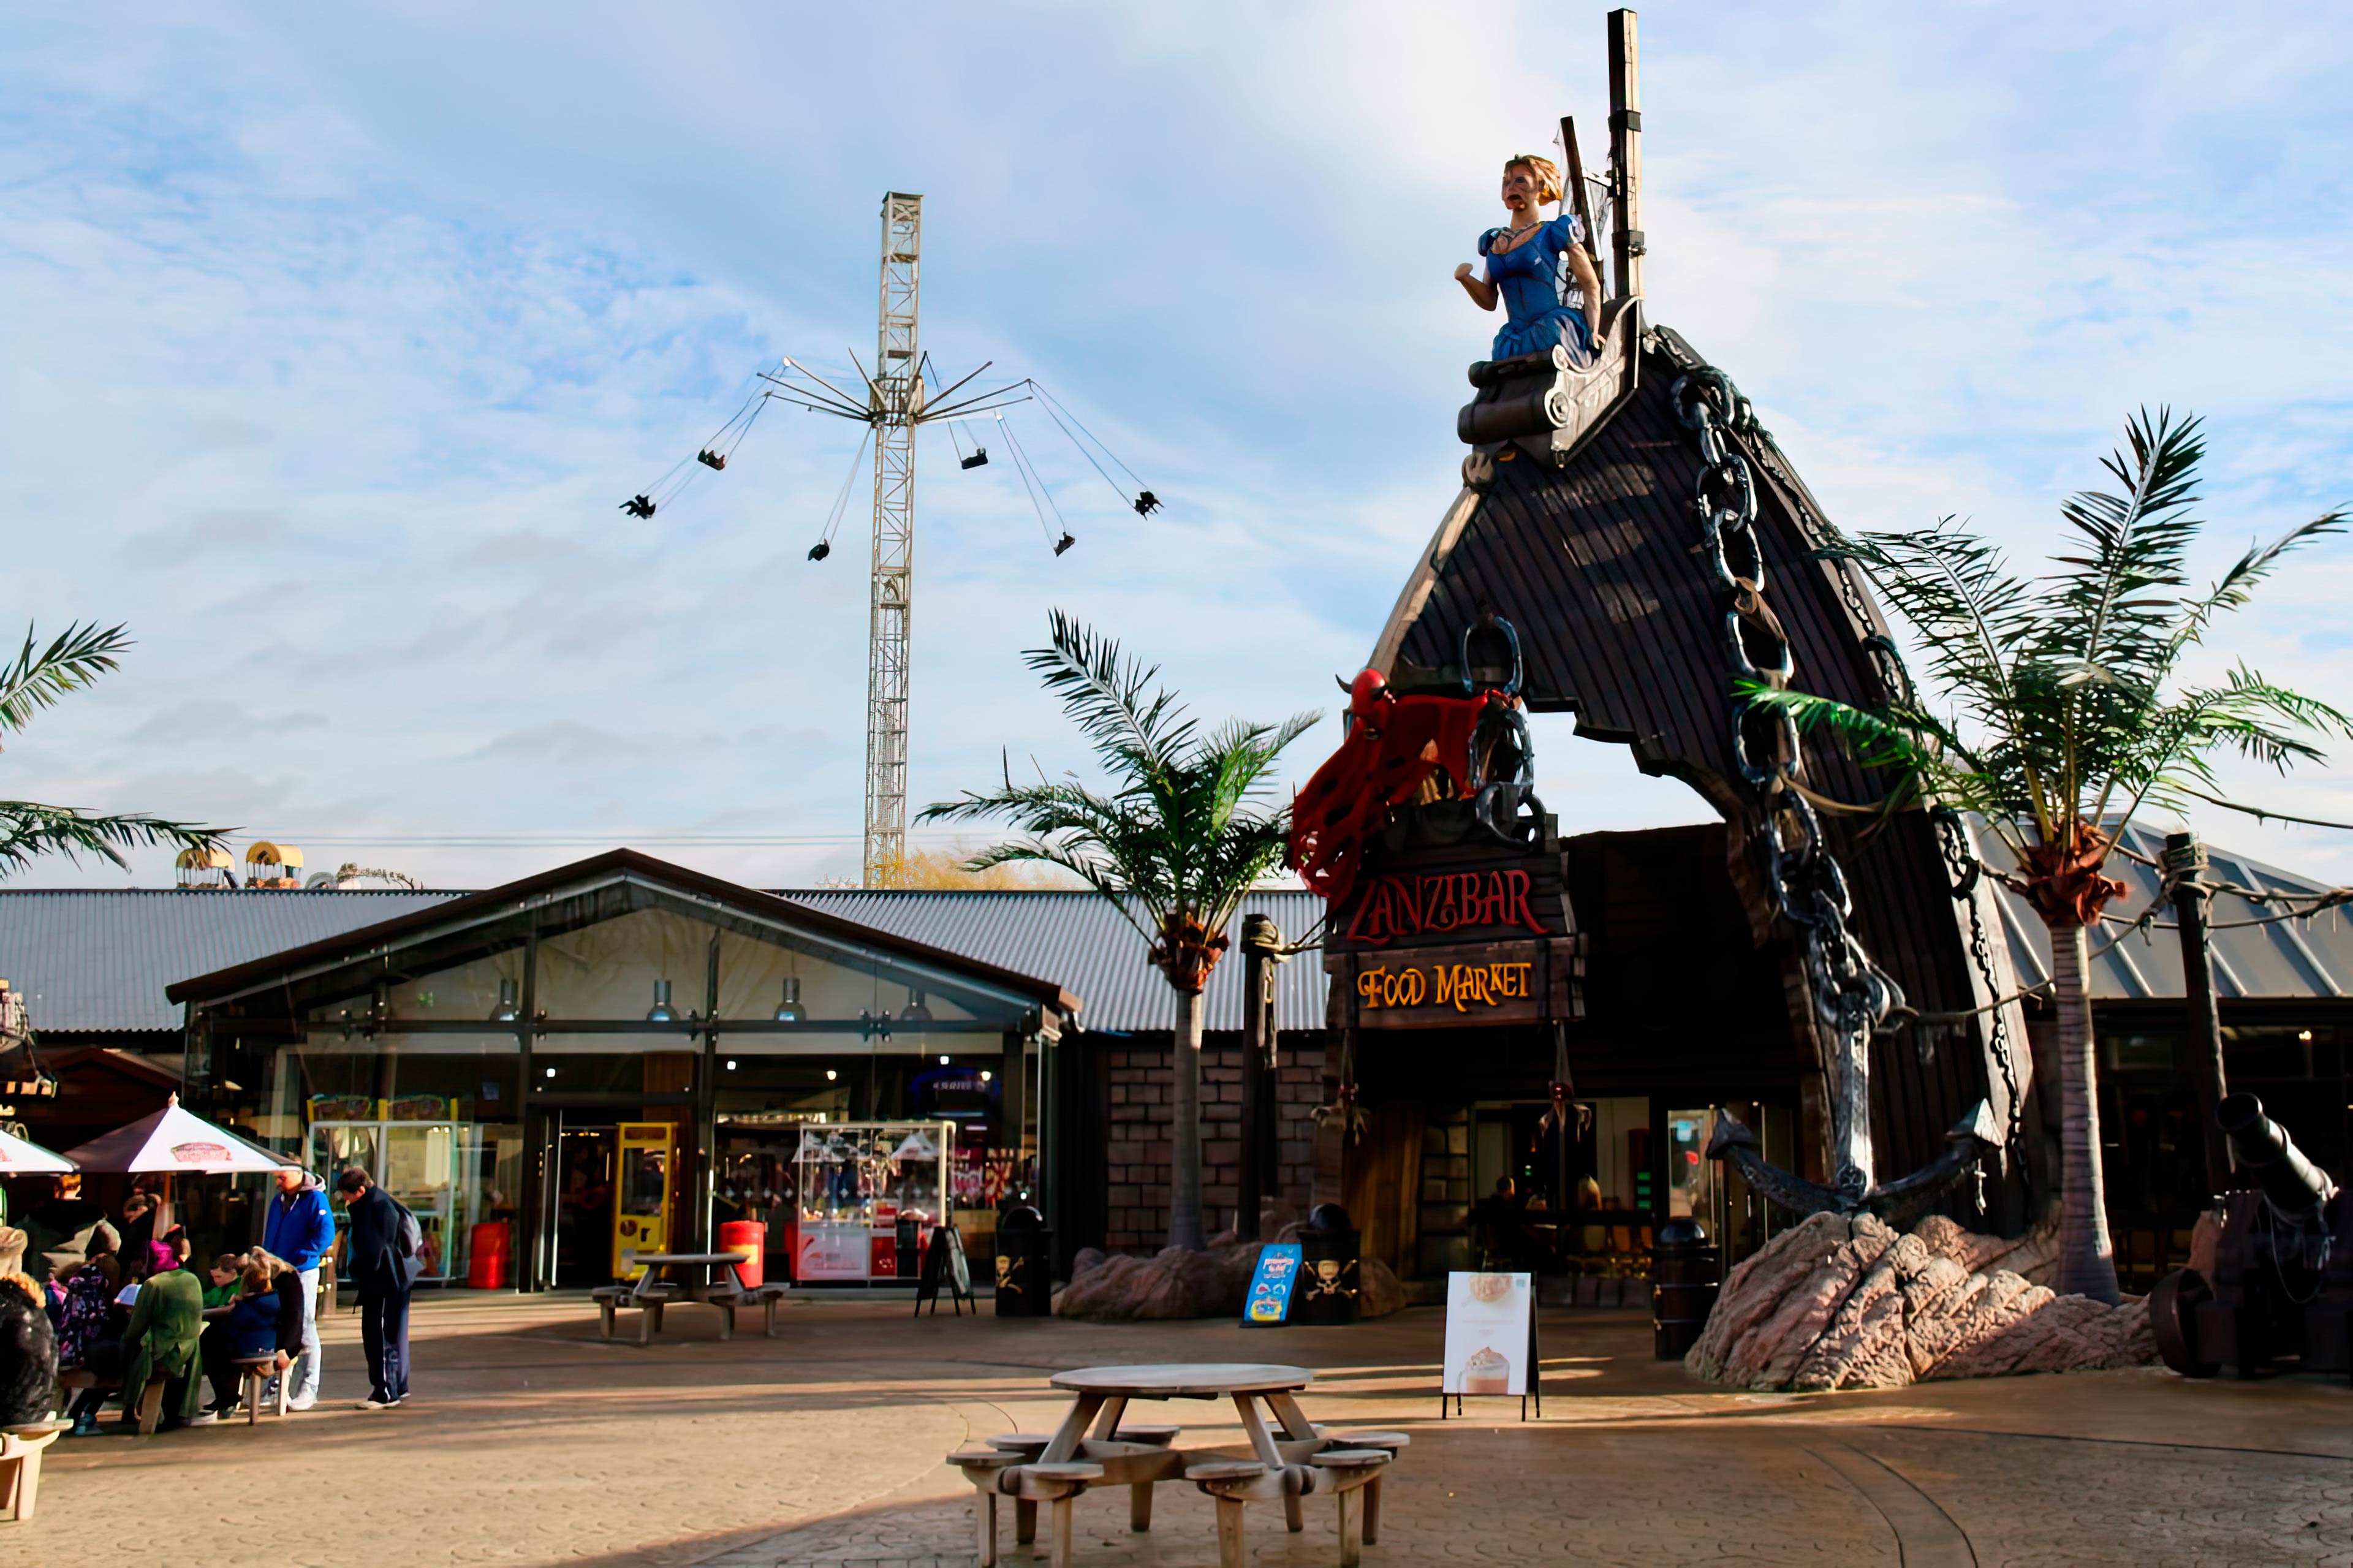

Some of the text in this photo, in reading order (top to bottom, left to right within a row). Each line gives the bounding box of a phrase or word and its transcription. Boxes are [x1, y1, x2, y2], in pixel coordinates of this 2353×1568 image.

[1346, 869, 1549, 946] ZANZIBAR
[1357, 963, 1531, 1012] FOOD MARKET
